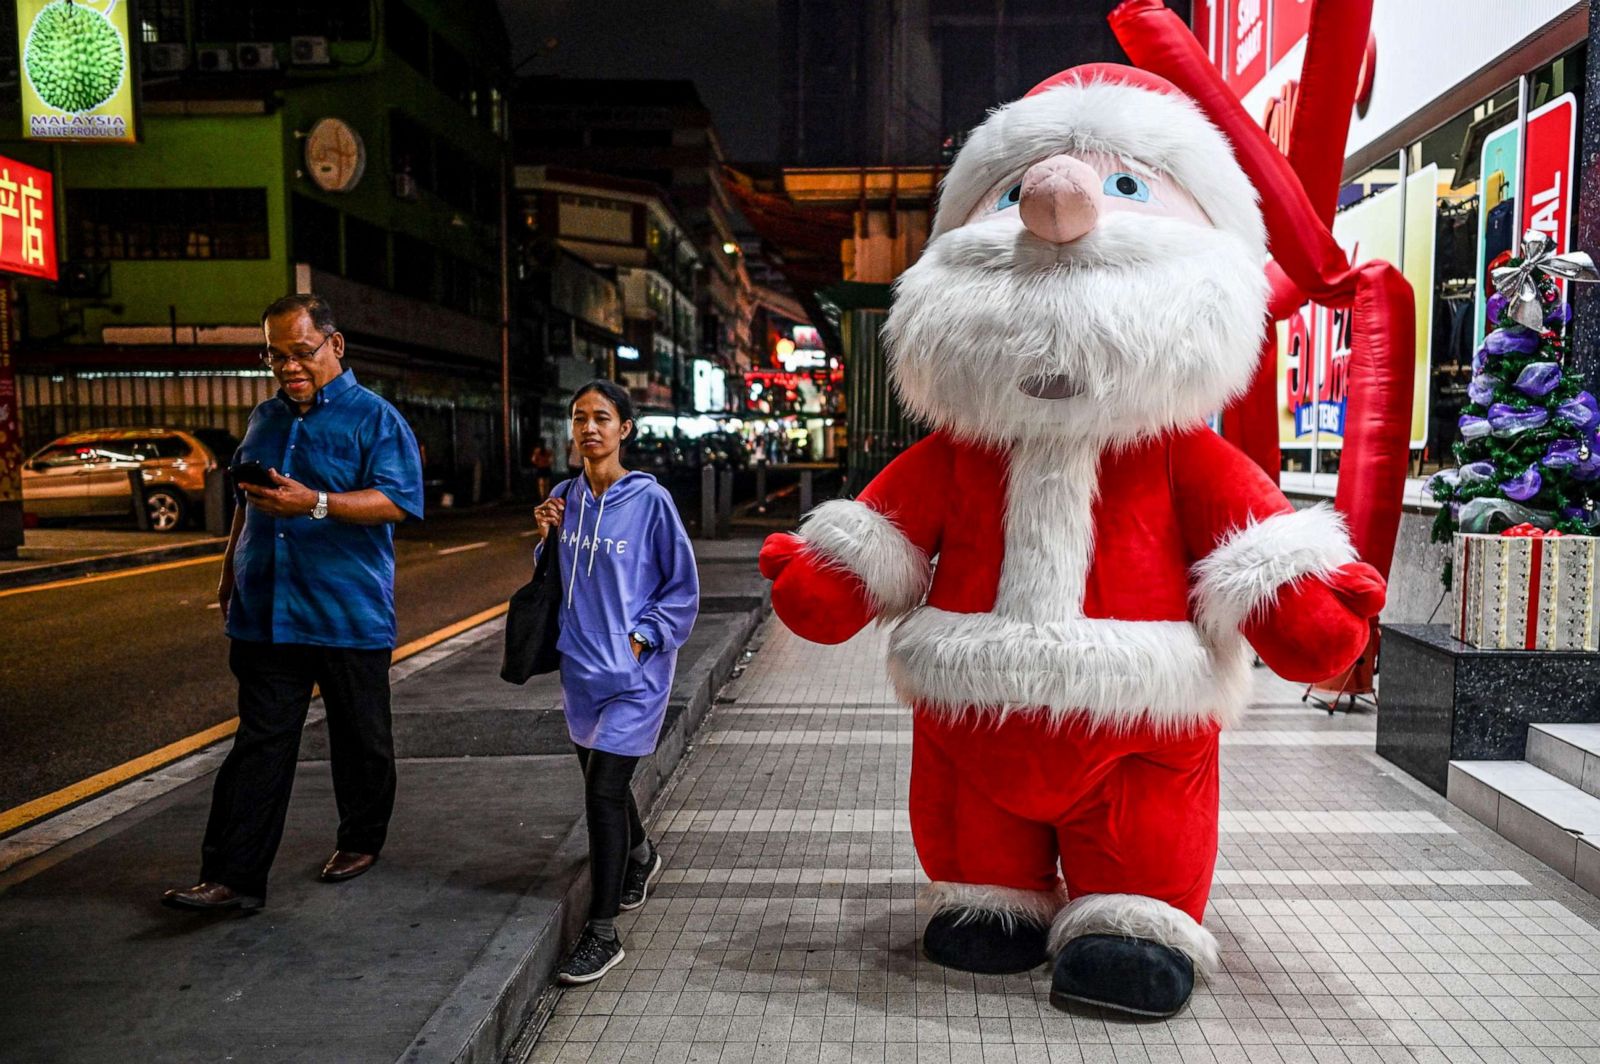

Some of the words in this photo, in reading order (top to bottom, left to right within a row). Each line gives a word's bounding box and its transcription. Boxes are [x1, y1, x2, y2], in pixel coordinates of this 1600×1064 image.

[31, 115, 125, 126] MALAYSIA
[31, 127, 69, 137] NATIVE
[71, 127, 126, 137] PRODUCTS
